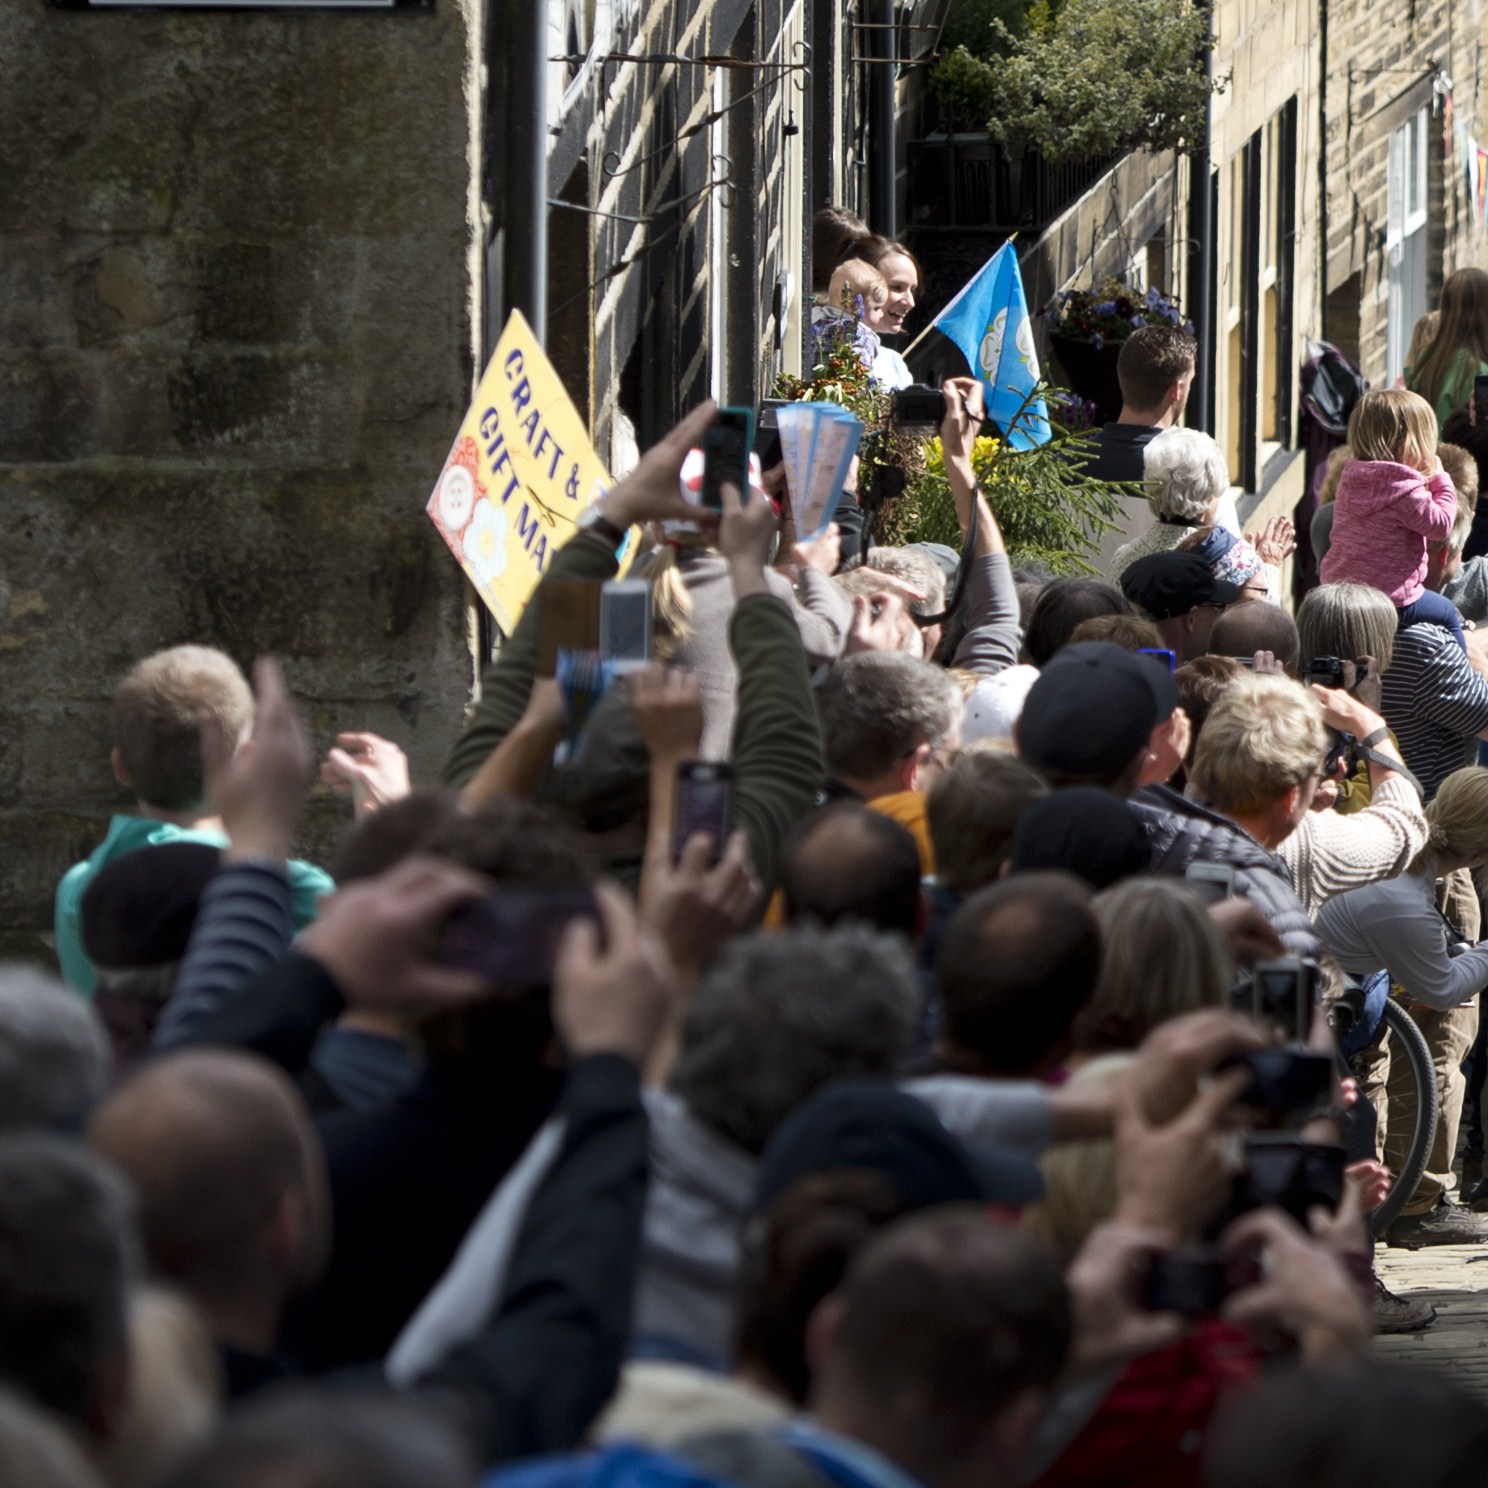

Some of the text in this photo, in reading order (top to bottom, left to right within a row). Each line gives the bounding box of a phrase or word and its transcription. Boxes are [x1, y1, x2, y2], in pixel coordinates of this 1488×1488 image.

[479, 406, 560, 575] GIFT MA
[504, 348, 581, 501] CRAFT &
